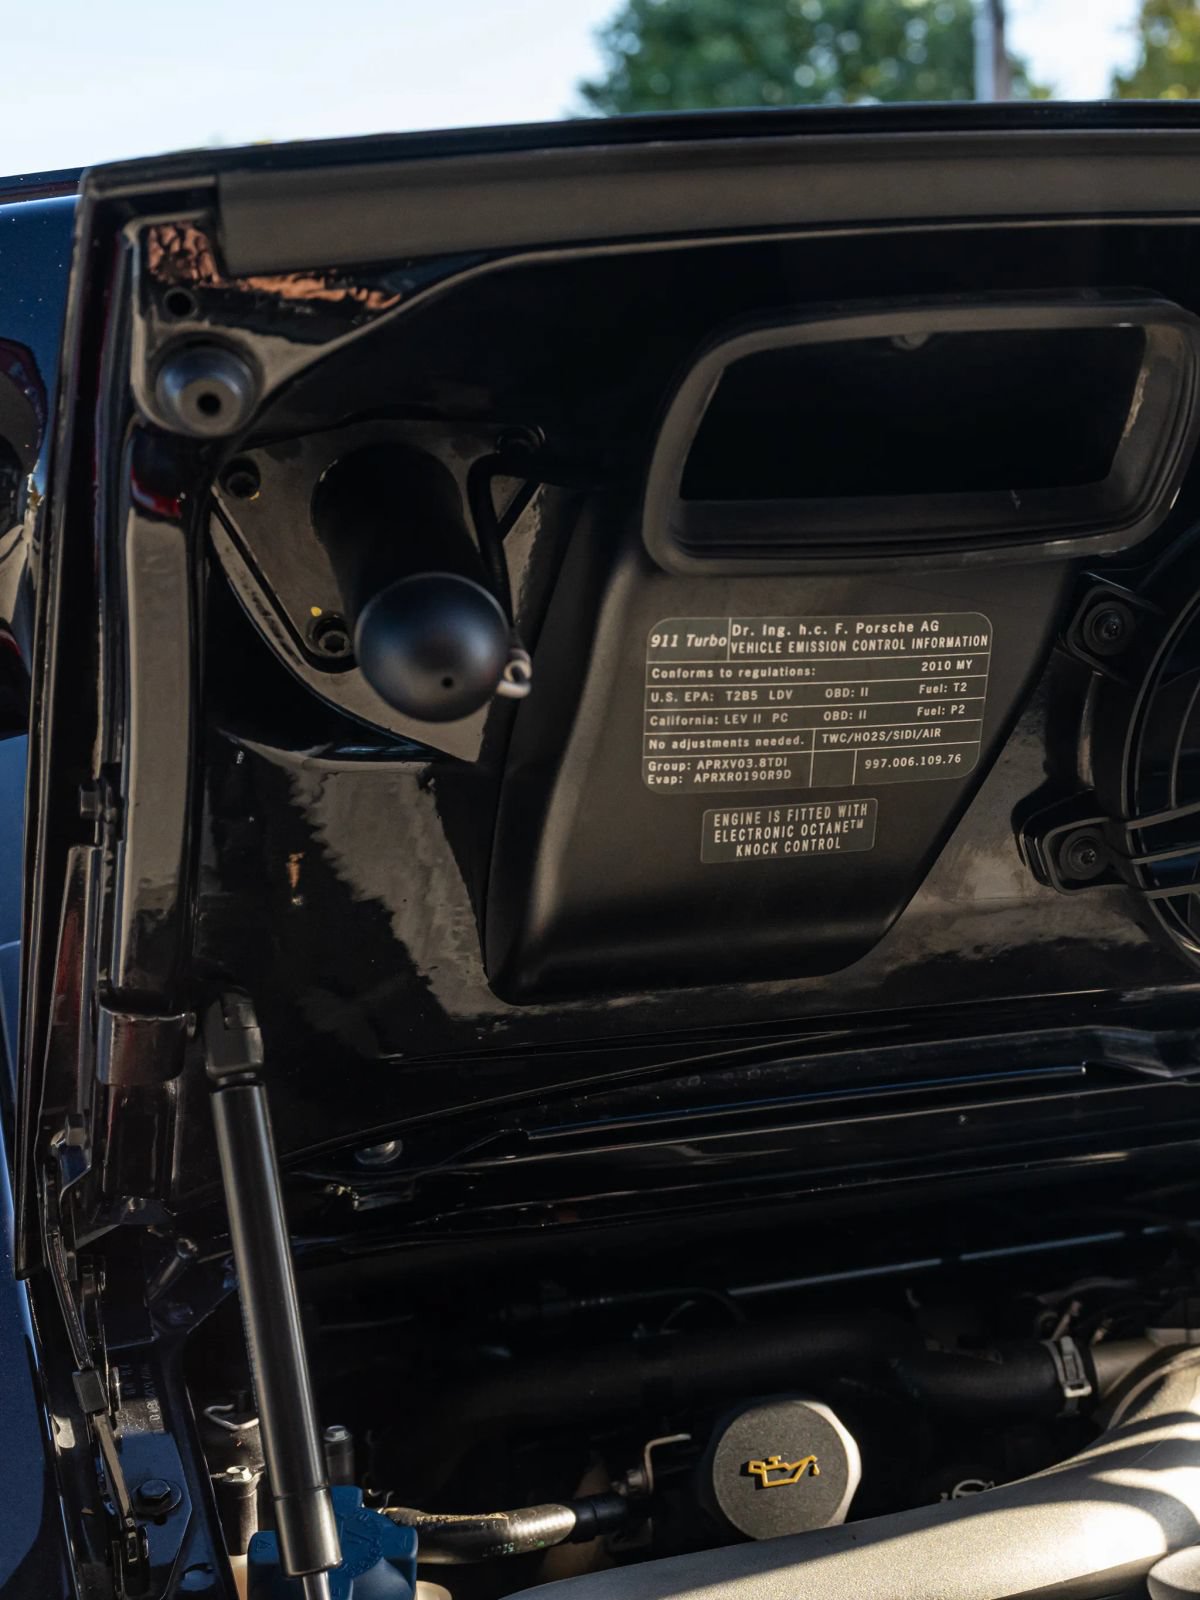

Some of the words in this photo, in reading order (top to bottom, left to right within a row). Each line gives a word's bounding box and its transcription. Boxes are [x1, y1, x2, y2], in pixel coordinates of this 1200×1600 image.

[732, 624, 755, 636] Dr.
[763, 624, 791, 638] Ing.
[800, 623, 827, 636] h.c.
[836, 623, 848, 635] F.
[856, 622, 914, 634] Porsche
[921, 620, 940, 632] AG
[651, 634, 678, 648] 911
[687, 634, 727, 647] Turbo
[731, 641, 782, 654] VEHICLE
[788, 640, 847, 654] EMISSION
[852, 639, 906, 652] CONTROL
[912, 635, 988, 649] INFORMATION
[921, 661, 952, 672] 2010
[957, 660, 973, 670] MY
[652, 668, 714, 679] Conforms
[720, 668, 733, 679] to
[738, 667, 816, 679] regulations:
[825, 688, 855, 699] OBD:
[861, 687, 869, 697] II
[919, 684, 948, 695] Fuel:
[954, 683, 968, 693] T2
[651, 692, 679, 703] U.S.
[685, 692, 714, 702] EPA:
[726, 691, 758, 701] T2B5
[769, 690, 794, 700] LDV
[824, 711, 853, 721] OBD:
[859, 710, 867, 720] II
[917, 706, 945, 717] Fuel:
[951, 705, 966, 714] P2
[650, 716, 719, 727] California:
[724, 714, 748, 725] LEV
[753, 714, 762, 724] II
[772, 713, 789, 723] PC
[649, 739, 665, 750] No
[672, 738, 749, 750] adjustments
[756, 736, 805, 747] needed.
[649, 761, 691, 773] Group:
[865, 754, 961, 769] 997.006.109.76
[648, 774, 683, 785] Evap:
[714, 812, 762, 827] ENGINE
[769, 810, 780, 823] IS
[787, 807, 831, 822] FITTED
[838, 804, 868, 817] WITH
[715, 825, 794, 843] ELECTRONIC
[736, 843, 778, 857] KNOCK
[785, 837, 841, 853] CONTROL
